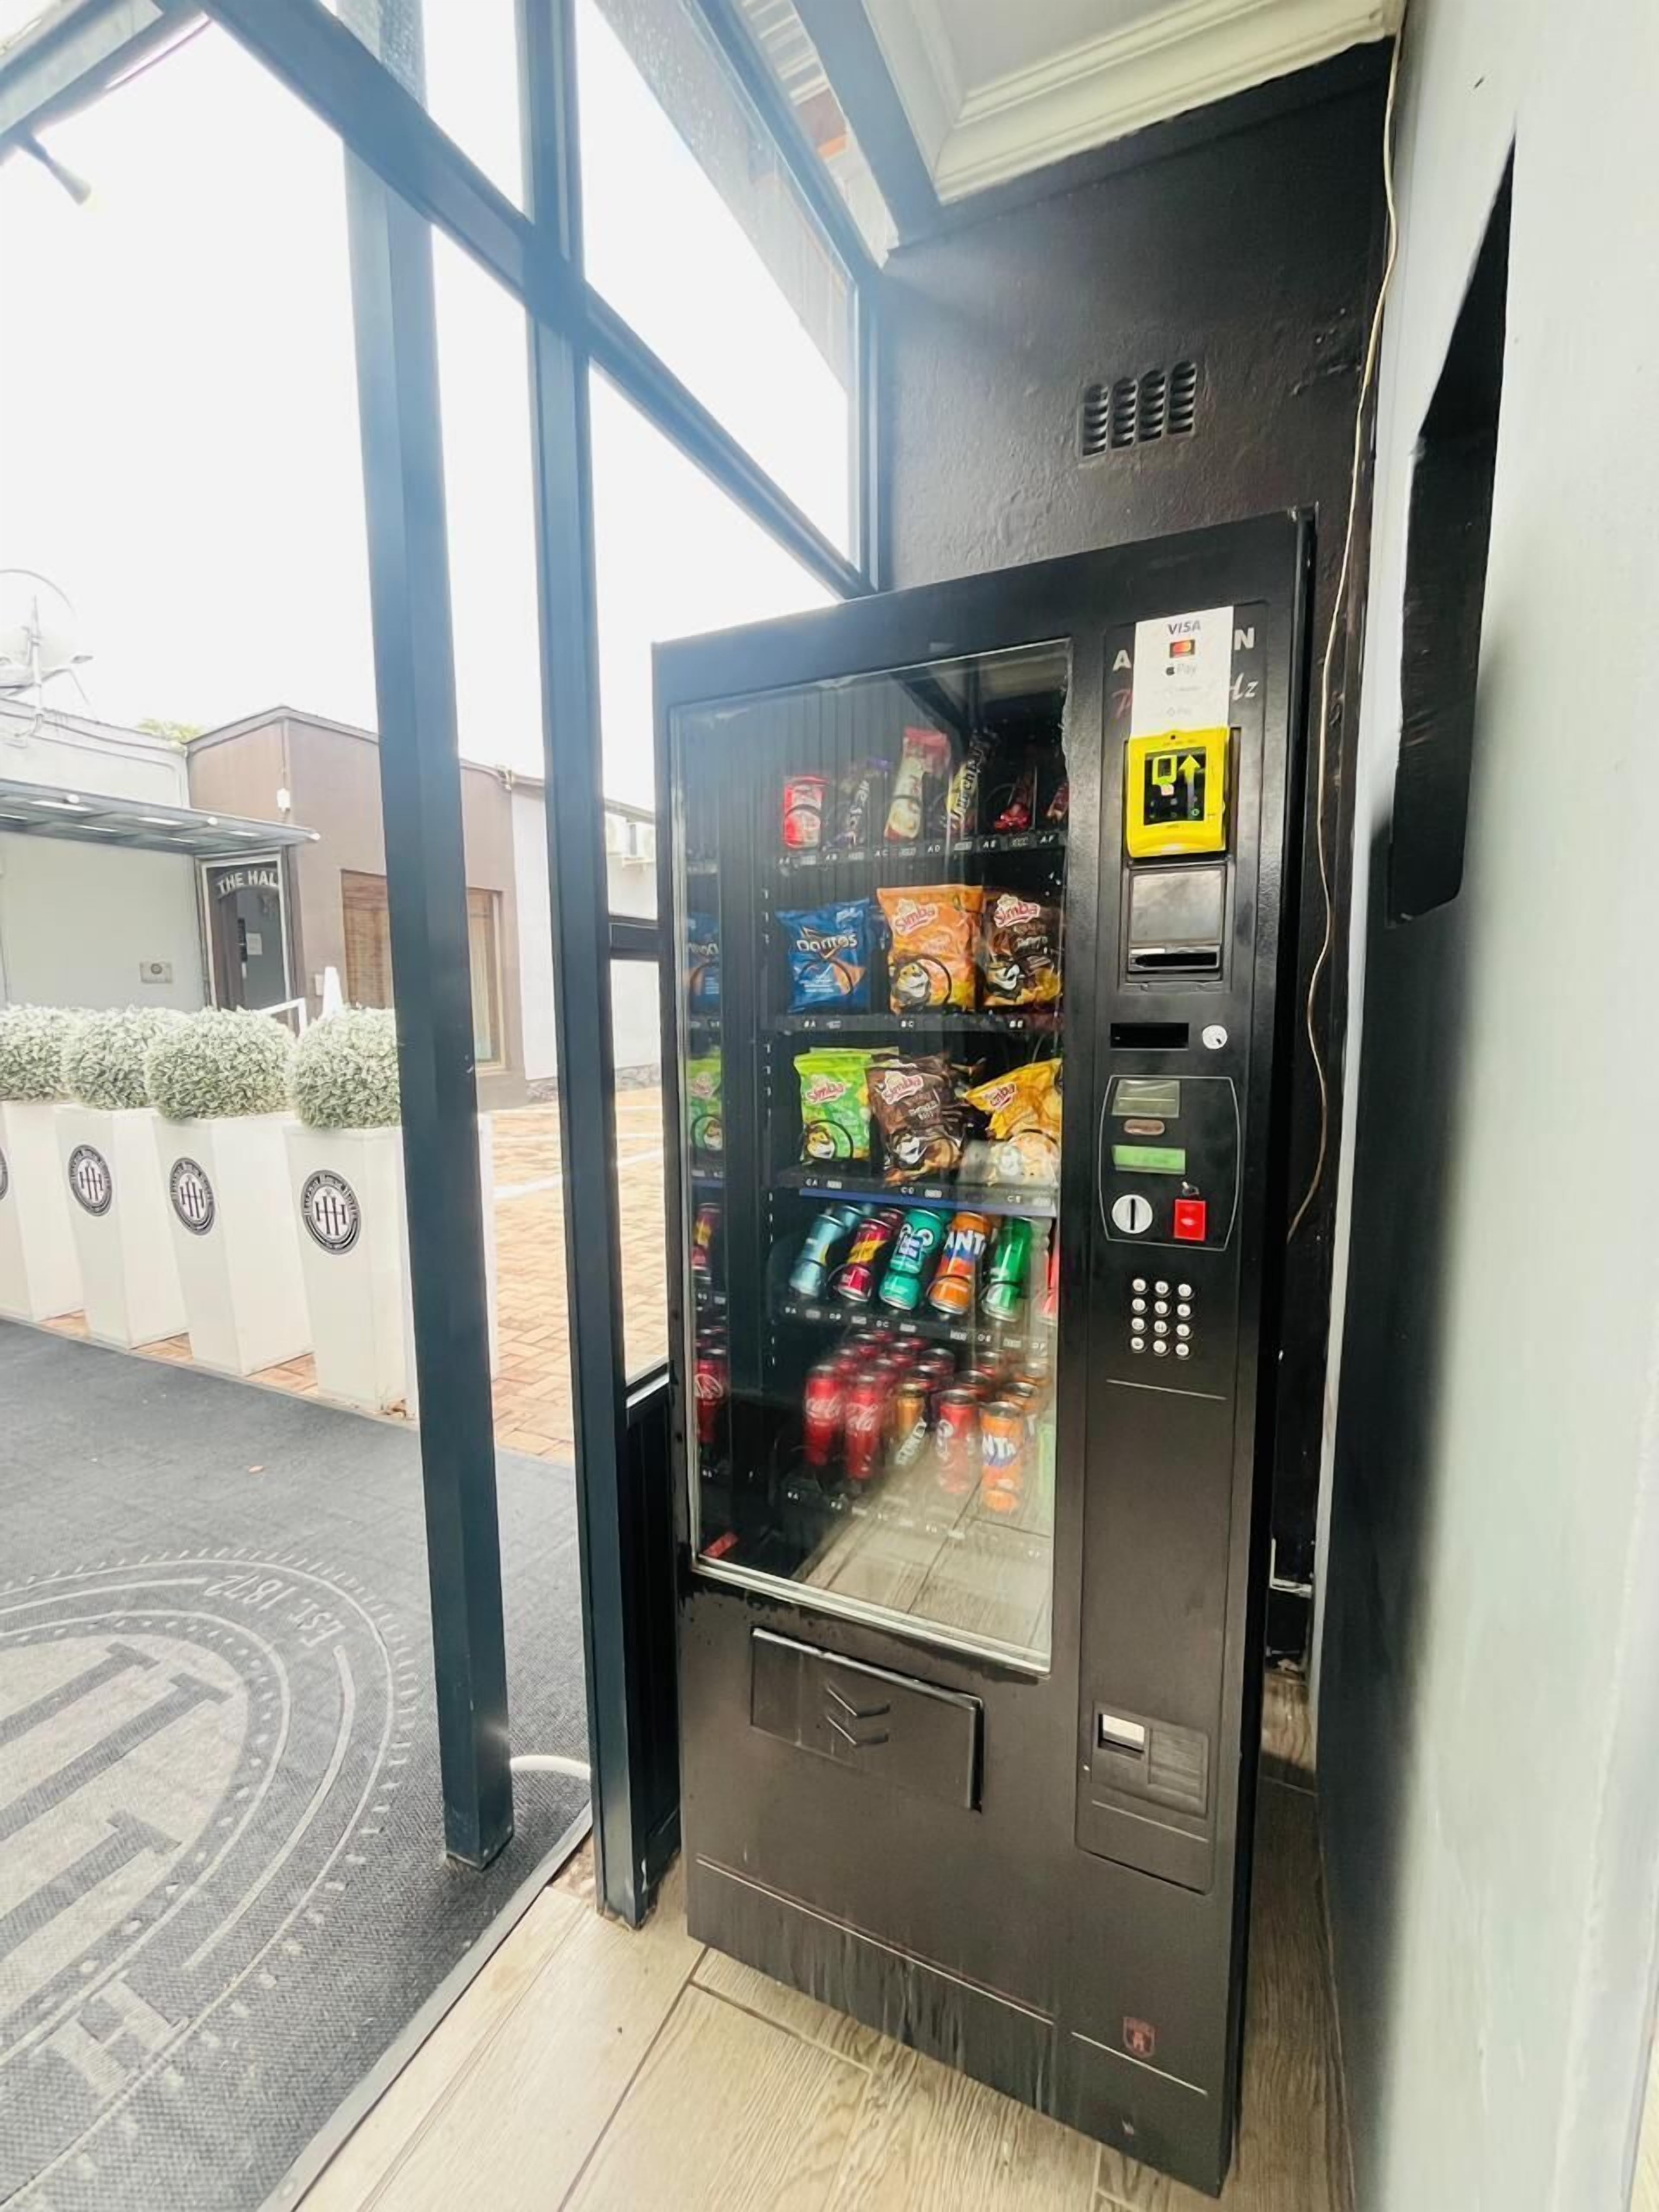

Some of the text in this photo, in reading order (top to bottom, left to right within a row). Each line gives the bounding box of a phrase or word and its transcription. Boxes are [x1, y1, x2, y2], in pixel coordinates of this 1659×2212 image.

[1167, 620, 1201, 634] VISA
[218, 872, 244, 894] THE
[203, 1574, 300, 1611] 1872
